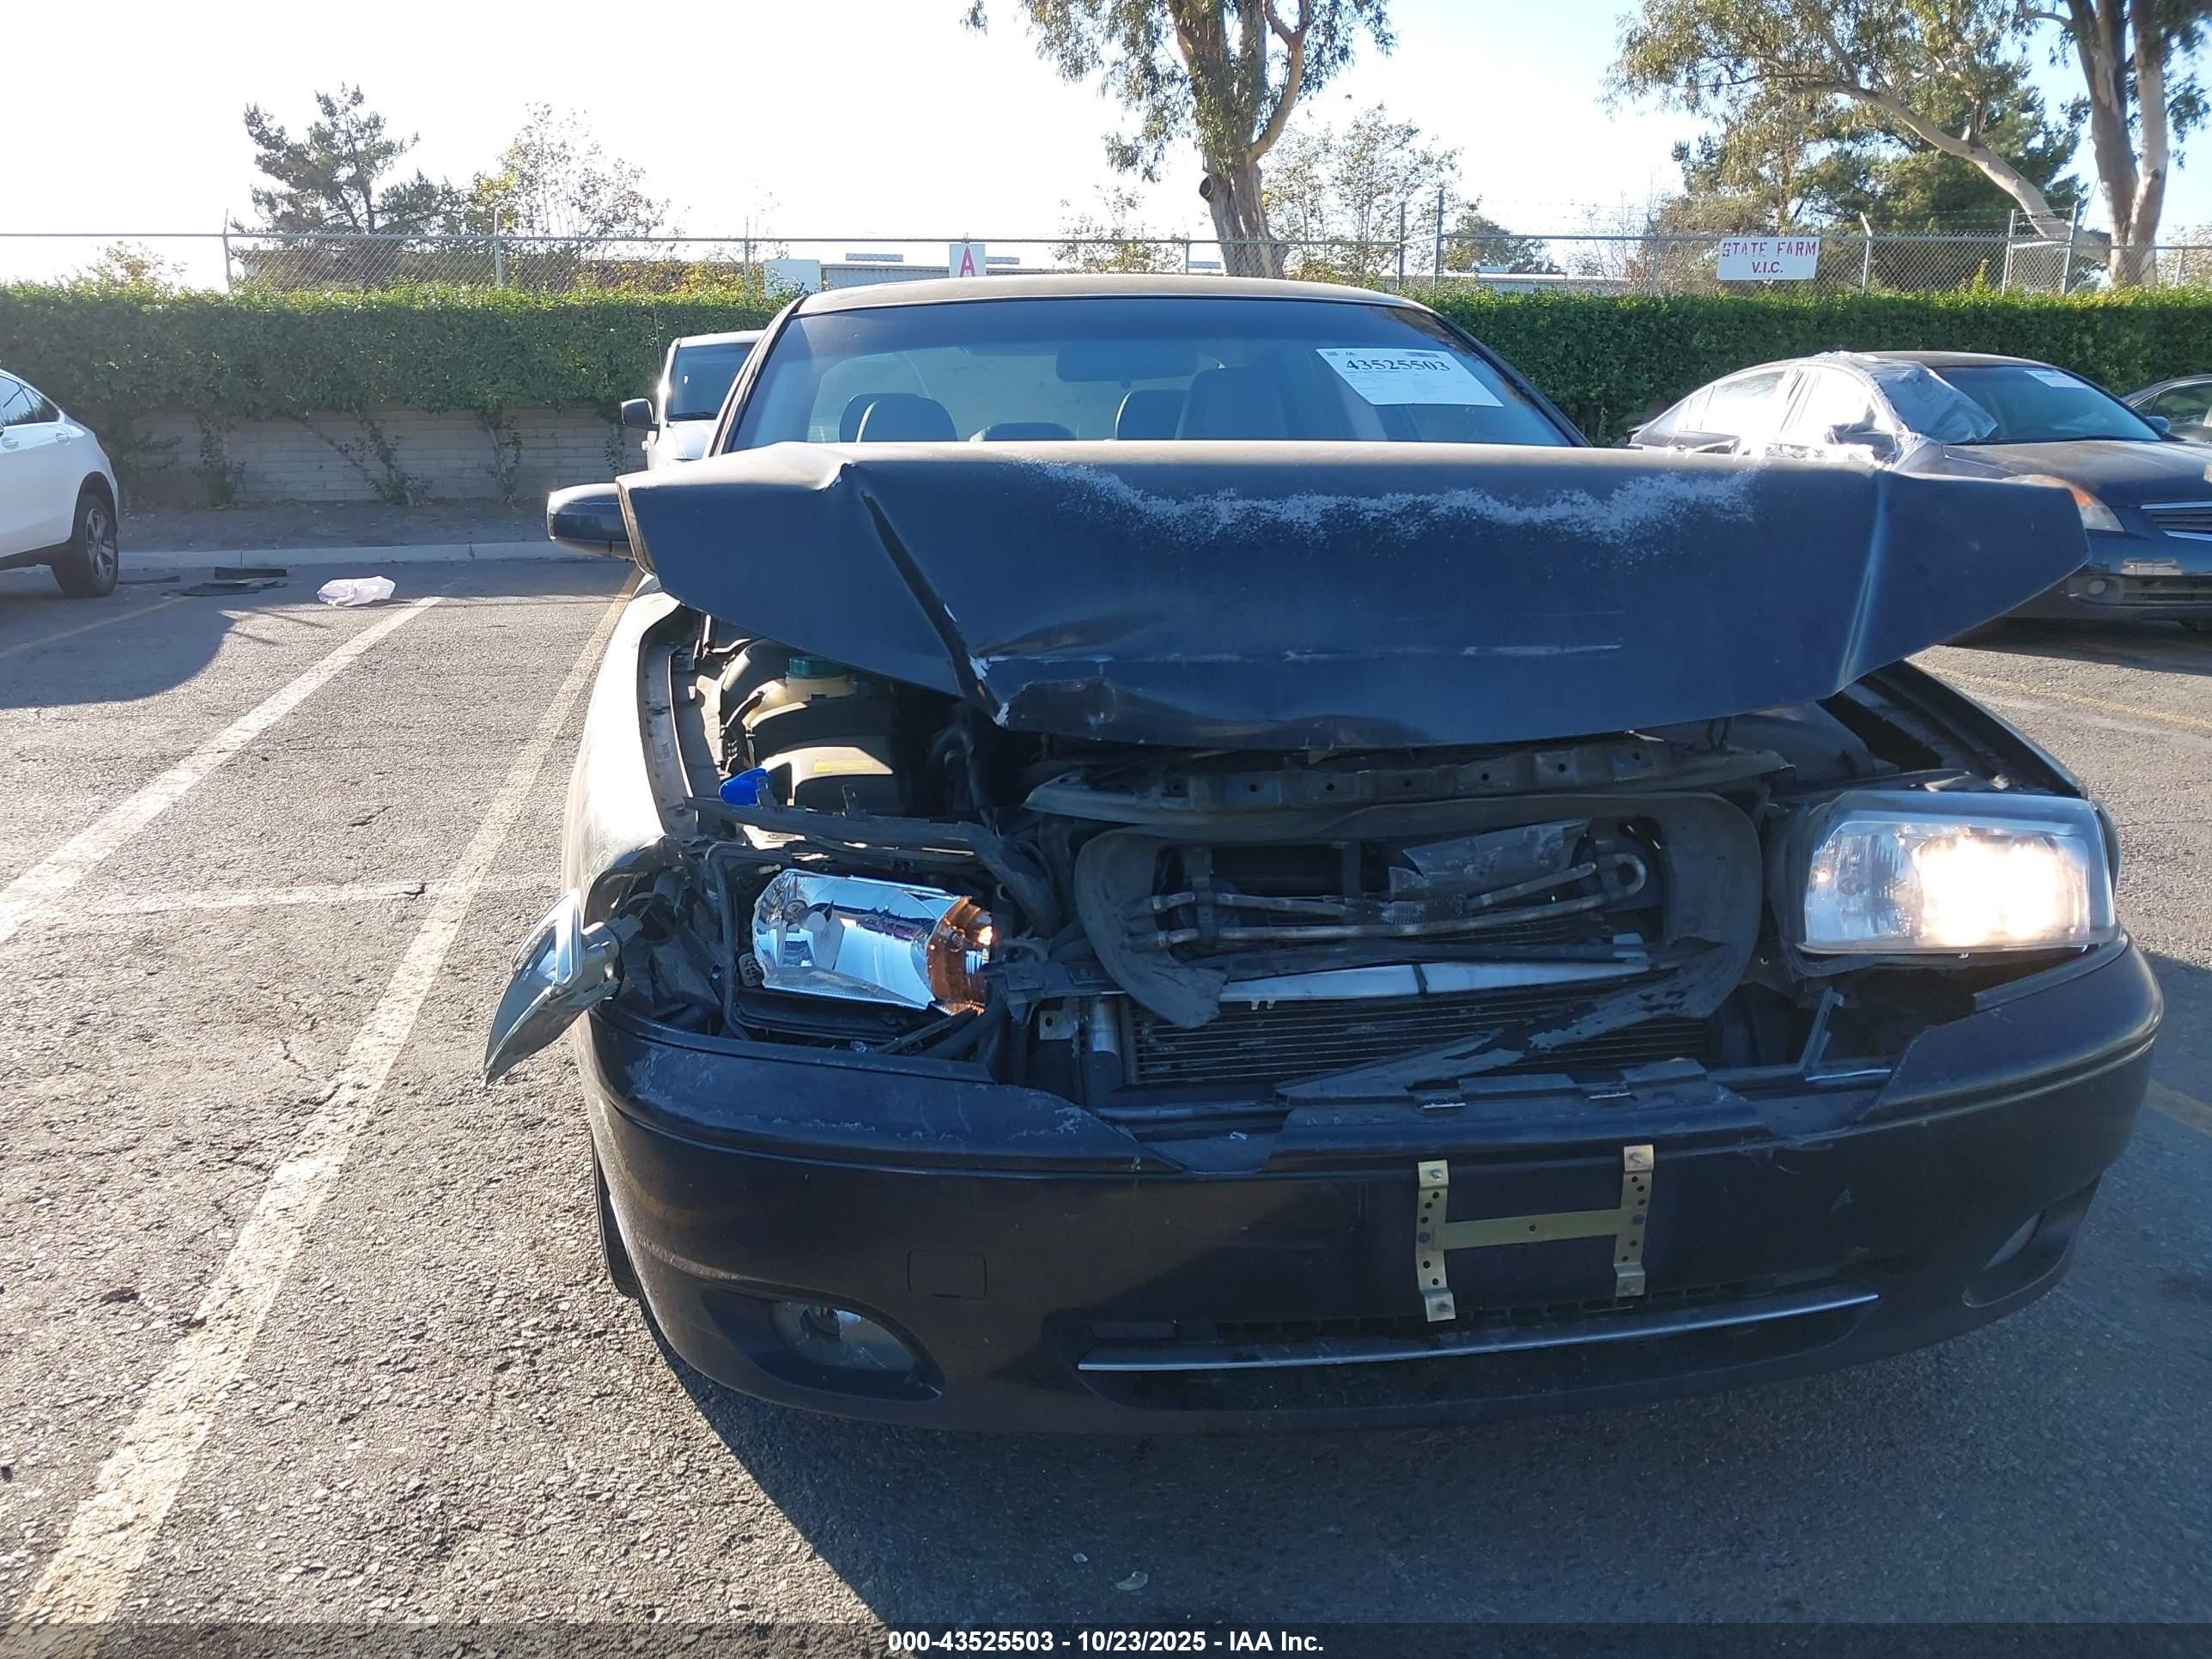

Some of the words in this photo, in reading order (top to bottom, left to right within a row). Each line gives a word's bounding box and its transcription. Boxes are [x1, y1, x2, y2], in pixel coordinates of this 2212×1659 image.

[1722, 241, 1768, 258] STATE
[1777, 240, 1817, 257] FARM
[959, 246, 976, 277] A
[1752, 261, 1784, 274] V.I.C.
[1346, 359, 1450, 372] 43525503
